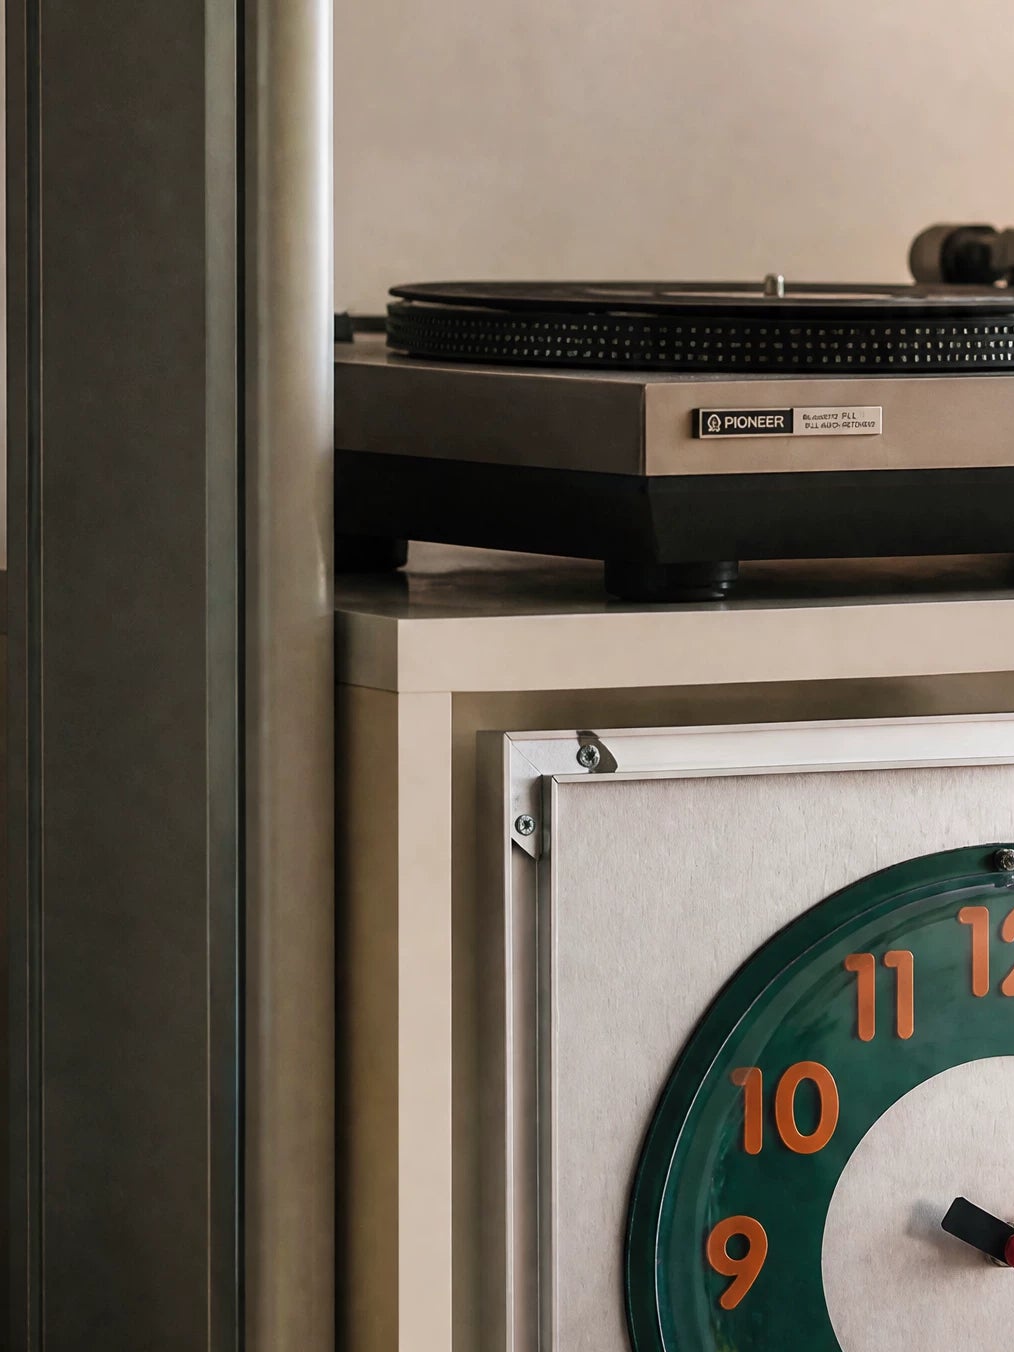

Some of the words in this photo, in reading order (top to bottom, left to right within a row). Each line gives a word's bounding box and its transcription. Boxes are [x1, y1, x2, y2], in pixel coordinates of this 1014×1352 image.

[724, 415, 784, 429] PIONEER
[844, 950, 914, 1041] 11
[731, 1061, 840, 1155] 10
[707, 1215, 768, 1310] 9
